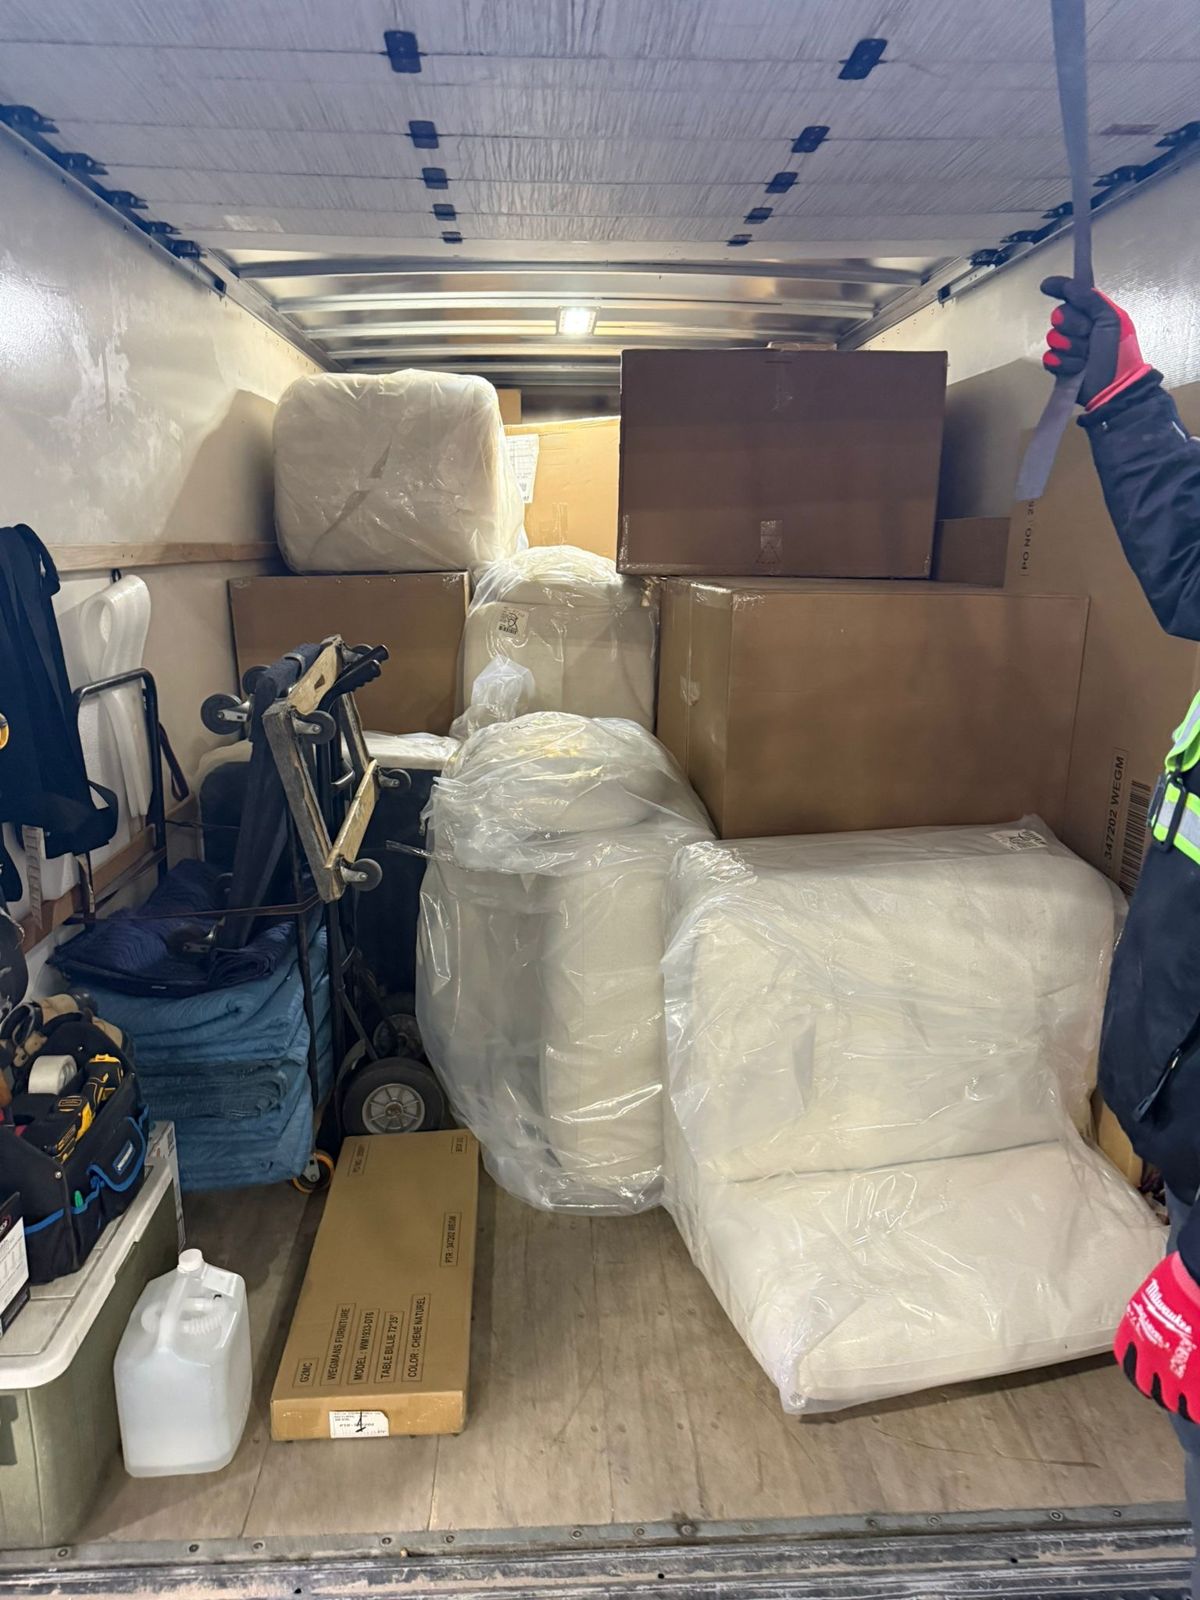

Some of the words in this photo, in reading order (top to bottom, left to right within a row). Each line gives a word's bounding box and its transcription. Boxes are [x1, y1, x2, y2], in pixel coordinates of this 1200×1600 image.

[1021, 551, 1030, 570] PO
[1110, 756, 1125, 806] WEGM
[1104, 809, 1118, 860] 347202
[414, 1296, 426, 1325] NATUREL
[1145, 1278, 1192, 1334] Milwaukee
[327, 1343, 343, 1380] WEGMANS
[335, 1307, 351, 1343] FURNITURE
[384, 1334, 396, 1354] BILLIE
[411, 1326, 422, 1348] CHENE
[300, 1362, 313, 1383] G2MC
[353, 1355, 367, 1380] MODEL
[381, 1355, 393, 1379] TABLE
[408, 1352, 420, 1378] COLOR
